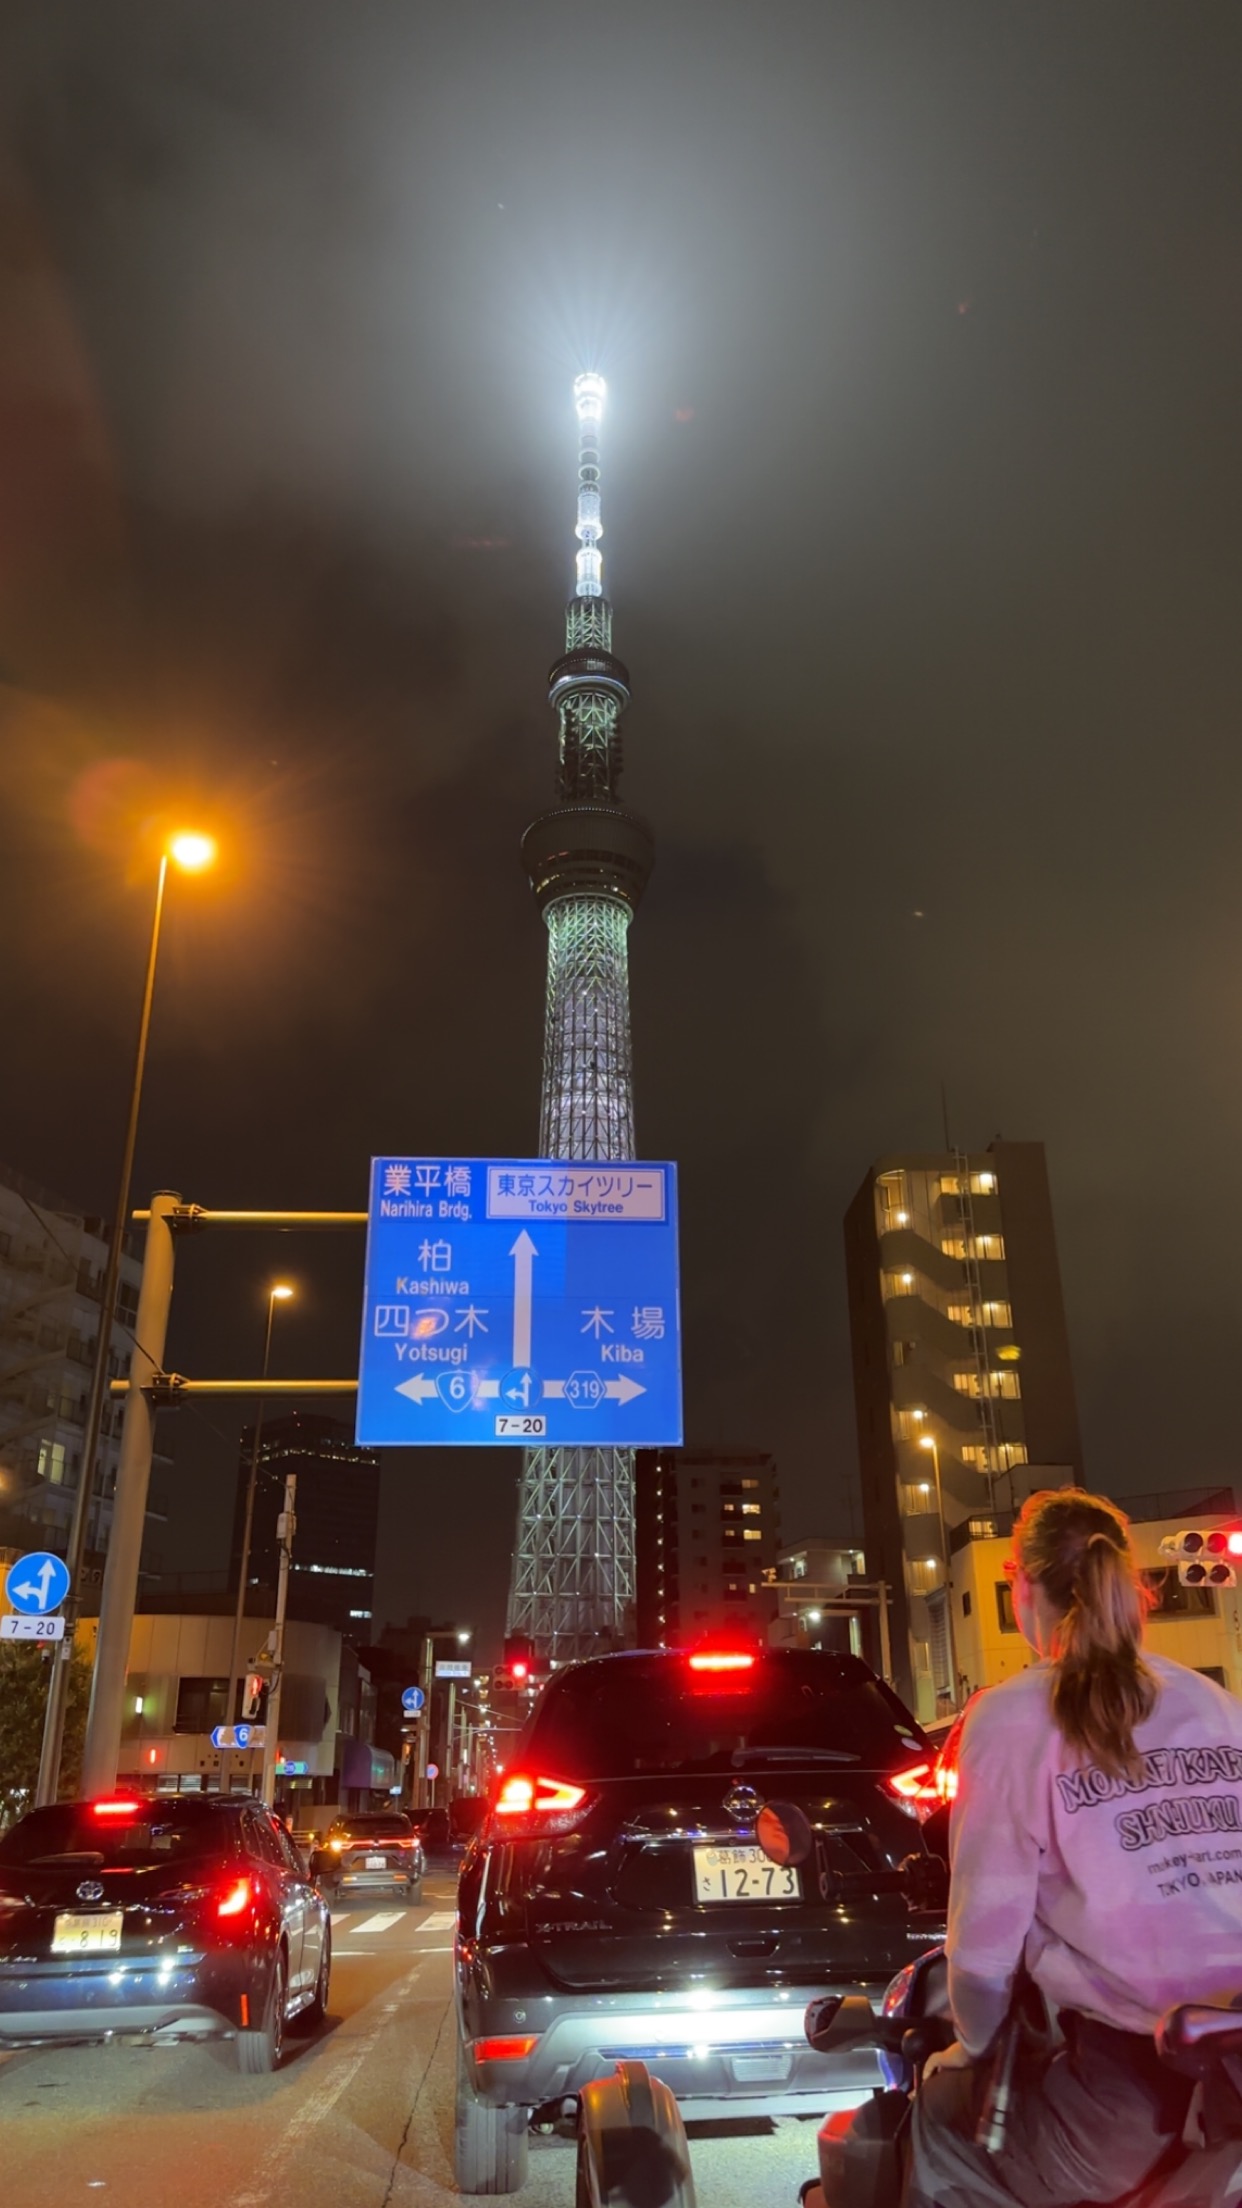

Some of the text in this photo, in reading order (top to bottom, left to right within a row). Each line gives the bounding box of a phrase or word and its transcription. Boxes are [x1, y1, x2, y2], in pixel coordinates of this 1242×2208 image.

[383, 1164, 472, 1197] 業平橋
[497, 1173, 653, 1198] 東京スカイツリー
[380, 1199, 472, 1221] Narihira Brdg.
[528, 1200, 624, 1215] Tokyo Skytree
[417, 1238, 452, 1272] 柏
[396, 1277, 470, 1295] Kashiwa
[374, 1304, 489, 1339] 四つ木
[580, 1305, 665, 1339] 木場
[395, 1343, 468, 1365] Yotsugi
[601, 1344, 644, 1362] Kiba
[450, 1376, 465, 1399] 6
[569, 1381, 599, 1399] 319
[498, 1418, 543, 1432] 7-20
[11, 1620, 55, 1635] 7-20
[239, 1728, 248, 1742] 6
[720, 1867, 795, 1897] 12-73
